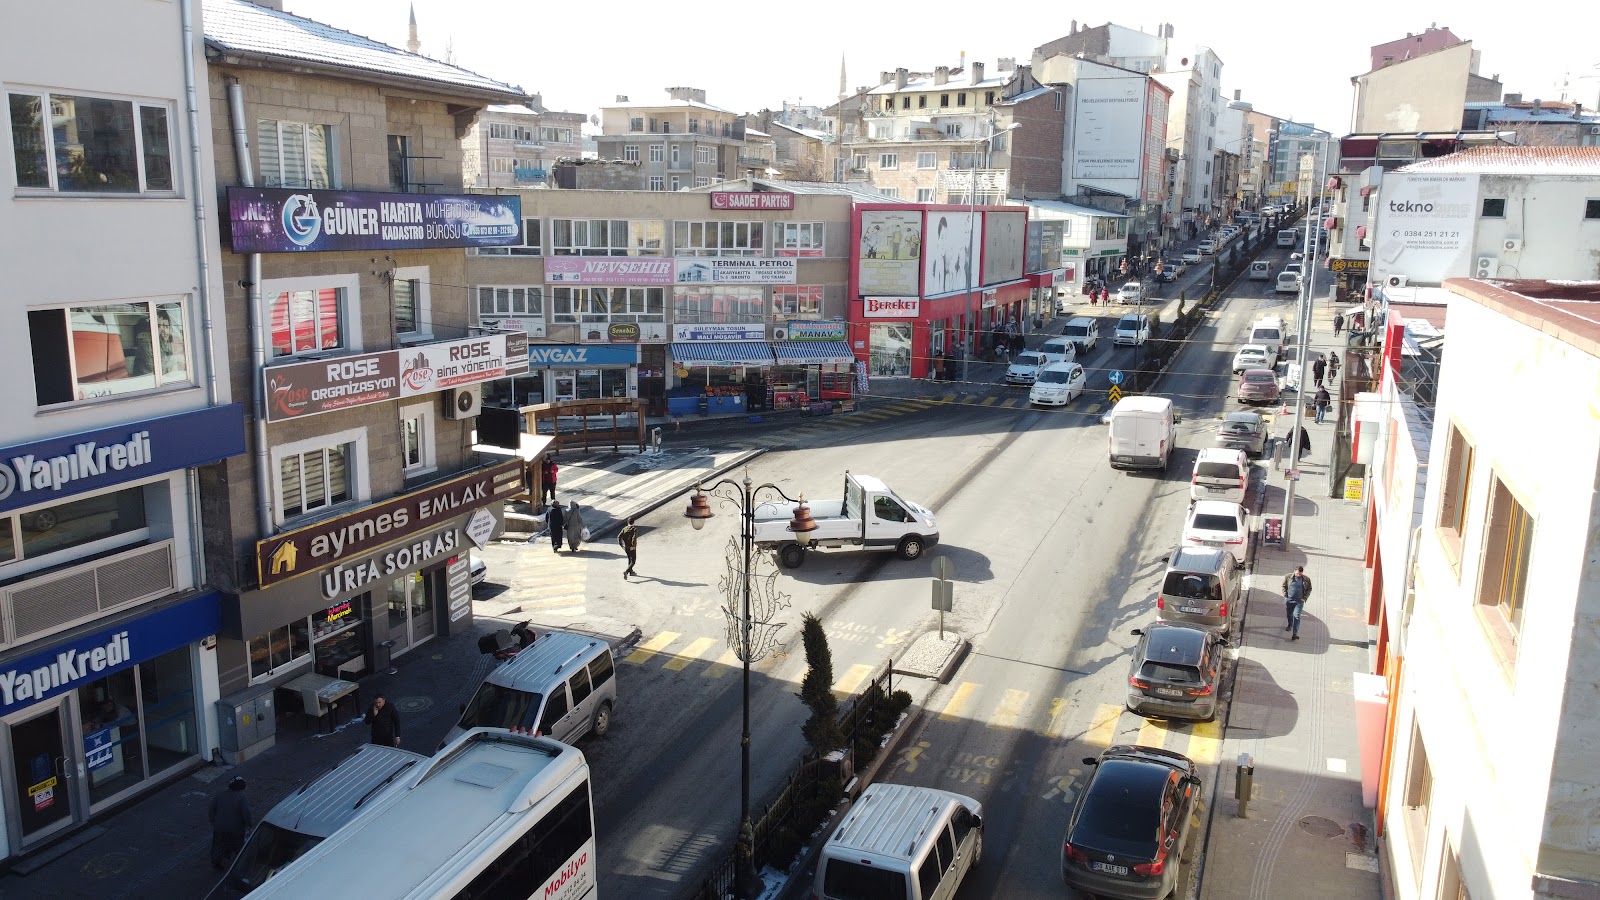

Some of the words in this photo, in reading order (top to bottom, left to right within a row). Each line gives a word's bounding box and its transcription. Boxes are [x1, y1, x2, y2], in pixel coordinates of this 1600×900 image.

[729, 194, 760, 207] SAADET
[323, 201, 380, 236] GÜNER
[382, 225, 425, 240] KADASTRO
[426, 221, 461, 240] BÜROSU
[582, 260, 671, 275] NEVŞEHİR
[799, 330, 833, 338] MANAV
[449, 341, 491, 362] ROSE
[529, 348, 588, 363] AYGAZ
[327, 358, 380, 382] ROSE
[461, 355, 503, 373] YÖNETİMİ
[311, 376, 396, 401] ORGANİZASYON
[11, 430, 152, 492] YapıKredi
[419, 480, 488, 520] EMLAK
[310, 507, 409, 559] aymes
[385, 528, 459, 575] SOFRASI
[0, 631, 131, 706] YapıKredi
[544, 852, 587, 900] Mobilya
